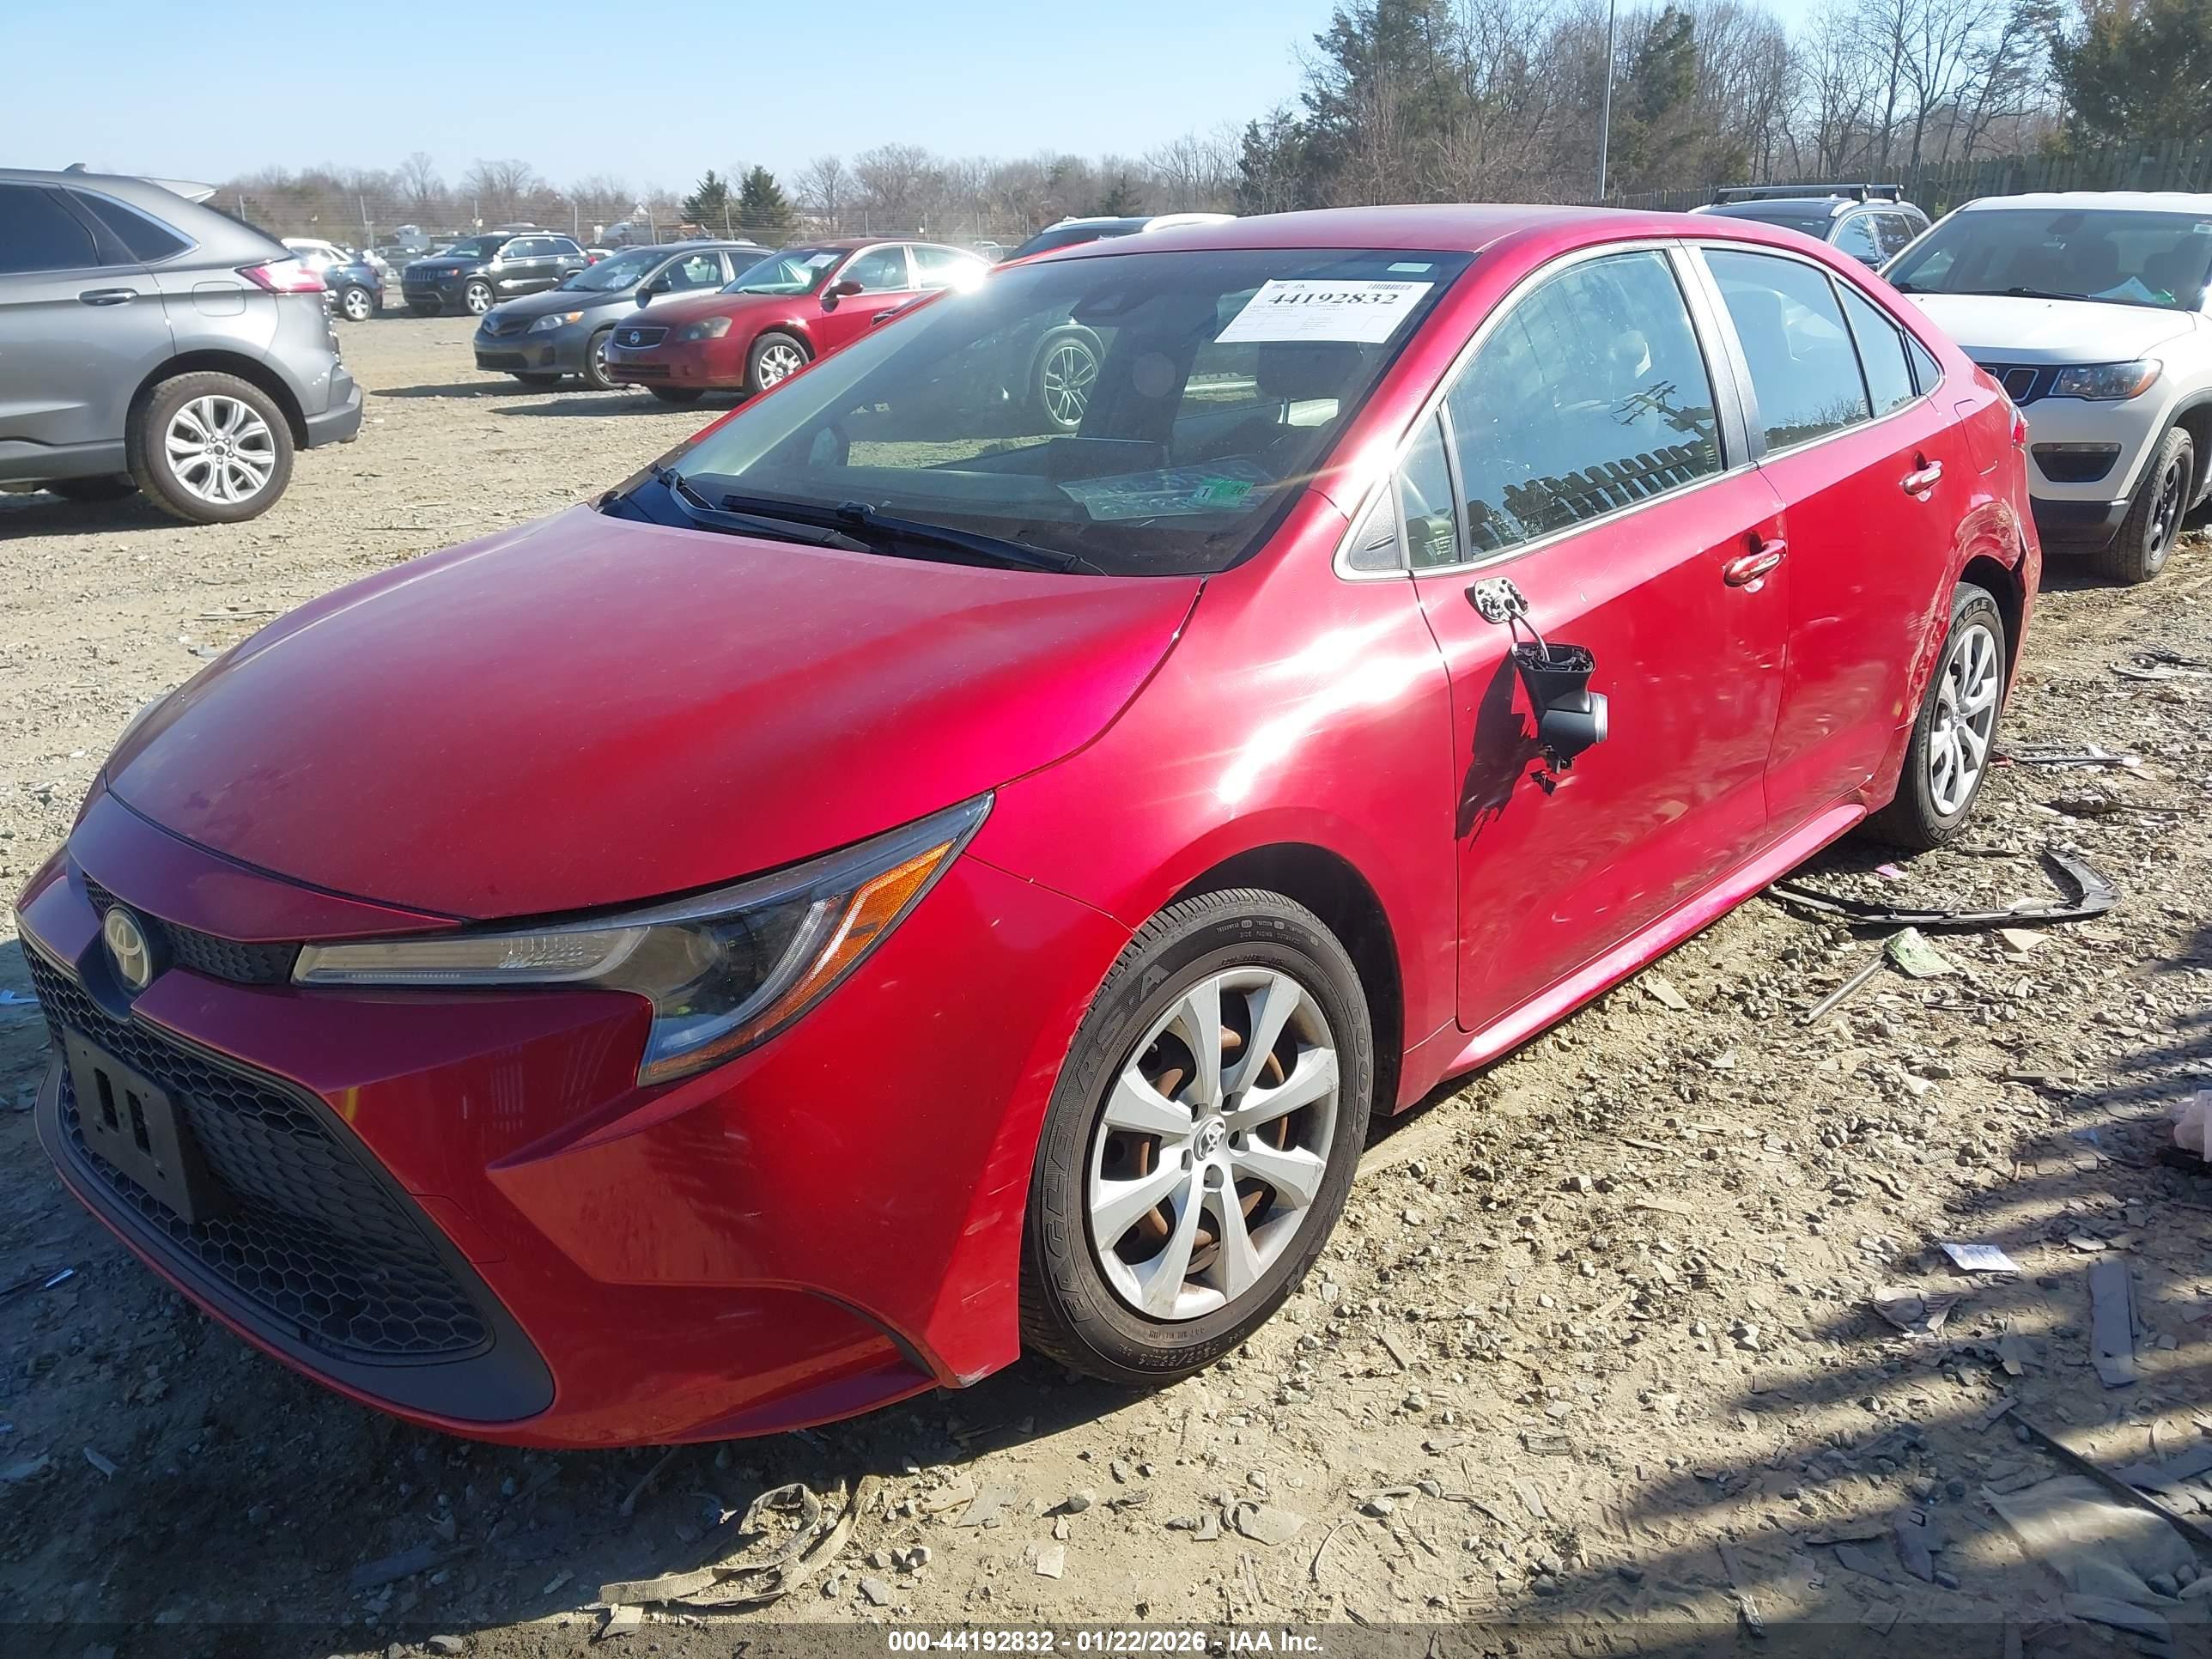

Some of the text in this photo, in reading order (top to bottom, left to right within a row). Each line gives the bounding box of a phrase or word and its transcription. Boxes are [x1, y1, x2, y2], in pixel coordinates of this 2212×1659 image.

[1267, 292, 1399, 304] 44192832
[1201, 487, 1210, 497] 1
[1948, 599, 1989, 649] EAGLE
[1286, 997, 1370, 1295] GOODYEAR
[1046, 1124, 1095, 1323] EAGLE
